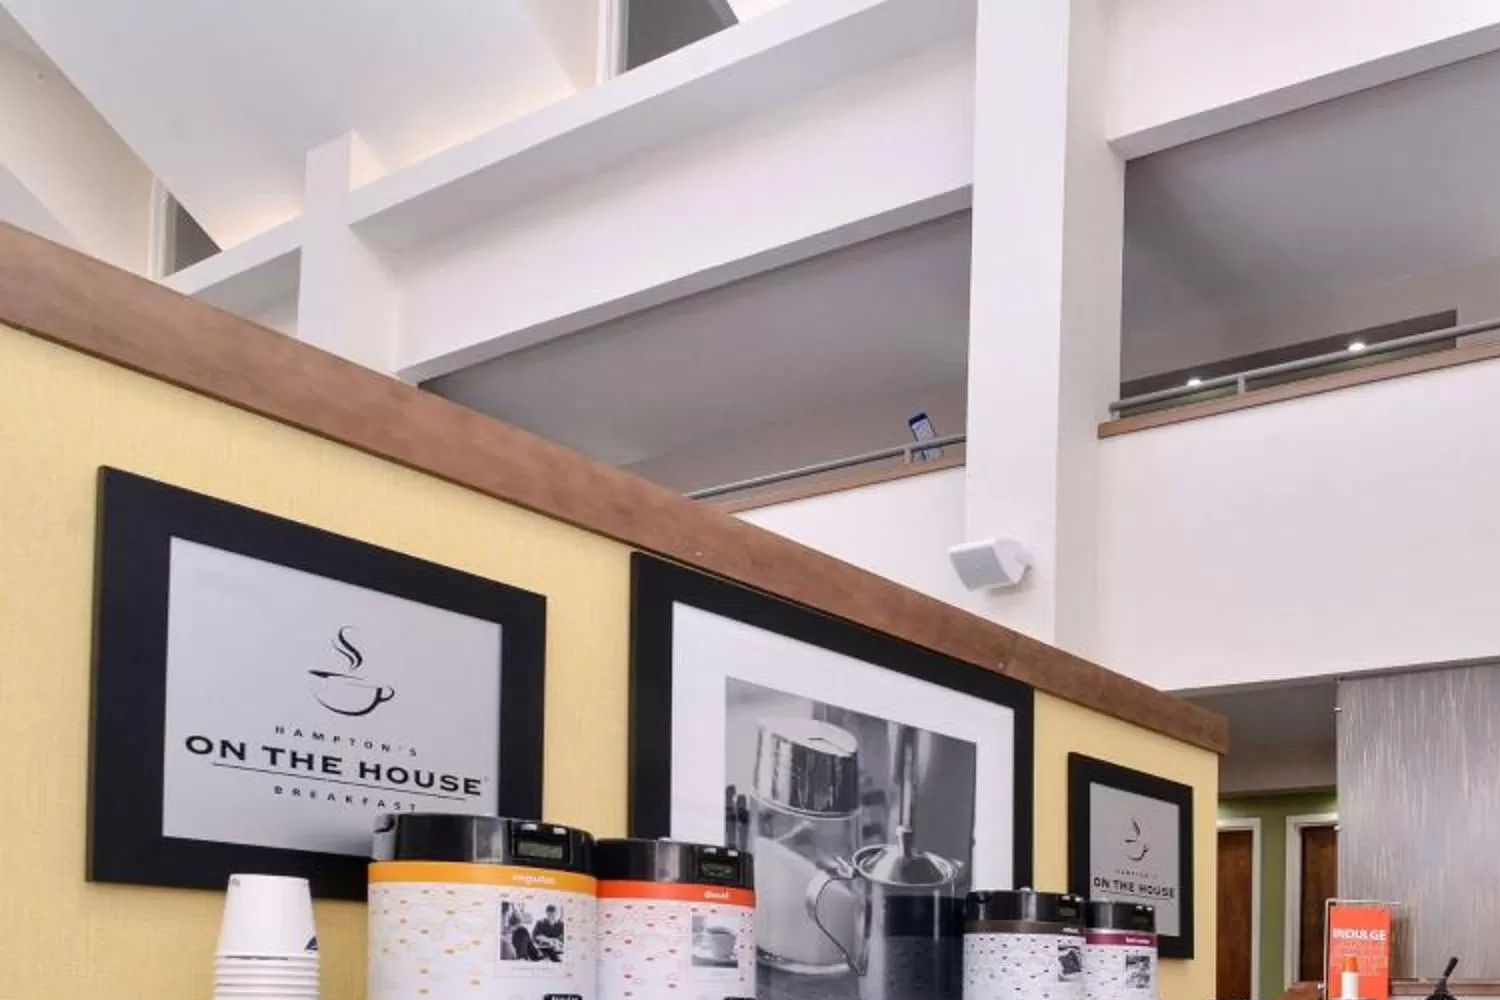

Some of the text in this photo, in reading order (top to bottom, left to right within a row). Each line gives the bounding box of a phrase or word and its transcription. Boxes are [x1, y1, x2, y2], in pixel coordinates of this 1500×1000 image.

[275, 725, 417, 758] HAMPTON'S
[185, 735, 482, 796] ON THE HOUSE
[273, 785, 417, 812] BREAKFAST
[1093, 877, 1175, 898] ON THE HOUSE
[1332, 928, 1387, 941] INDULGE
